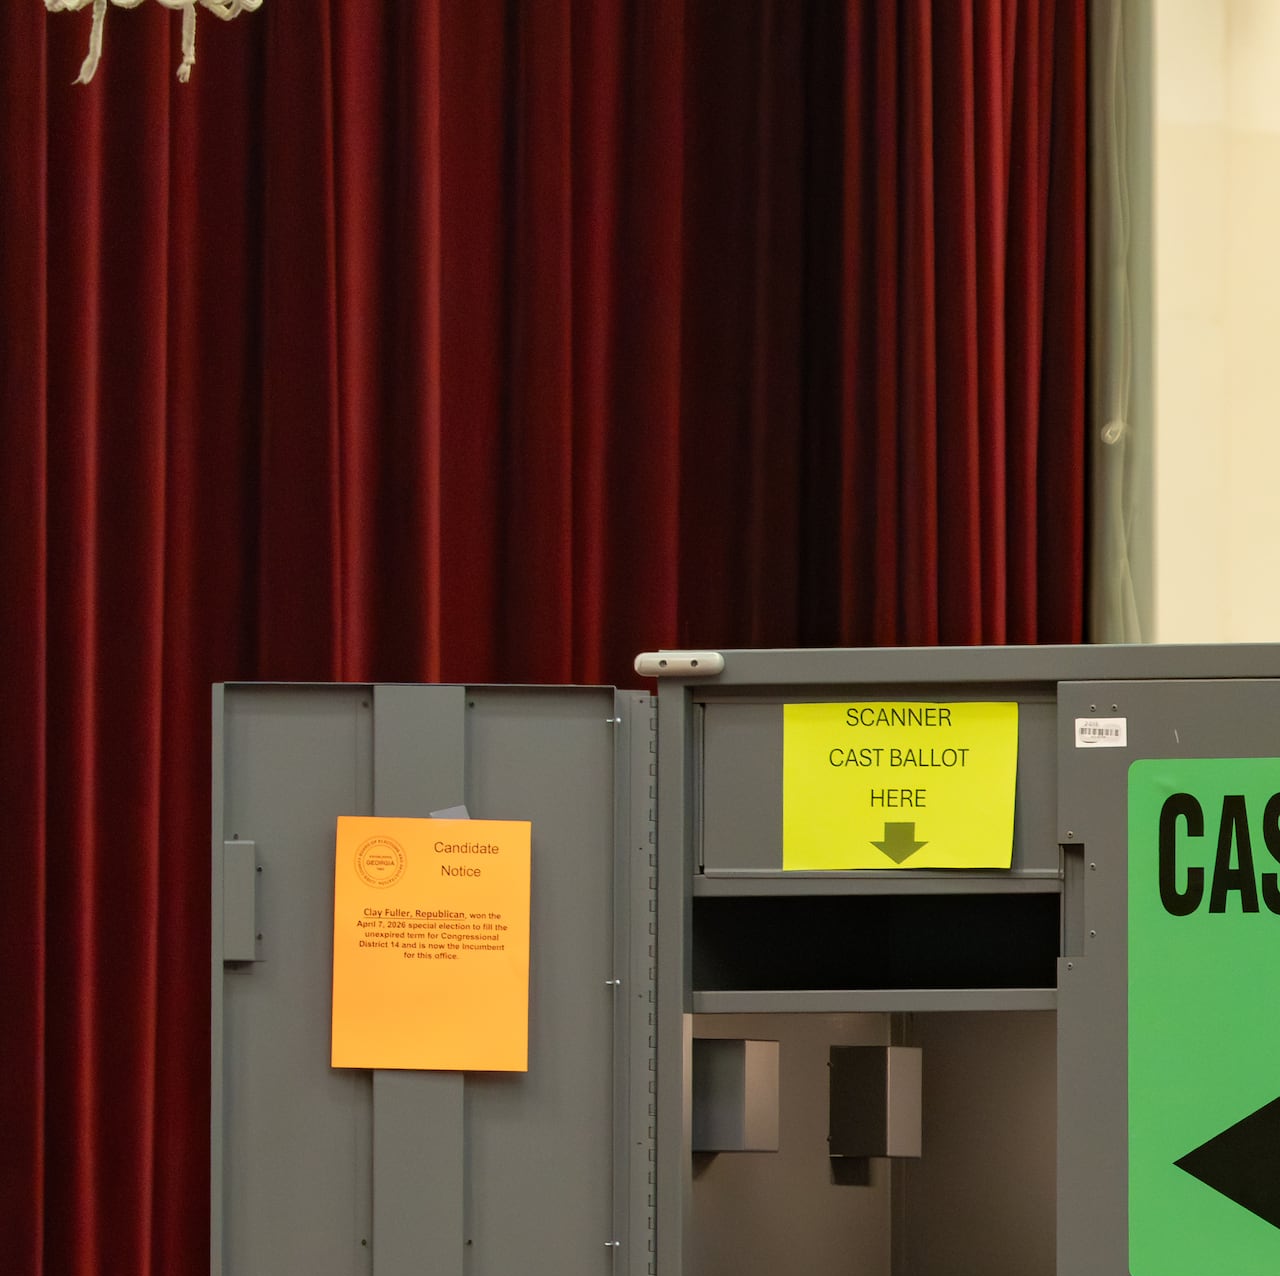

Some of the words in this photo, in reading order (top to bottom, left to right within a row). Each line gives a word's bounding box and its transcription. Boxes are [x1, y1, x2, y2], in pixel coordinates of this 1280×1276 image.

[846, 708, 952, 727] SCANNER
[829, 748, 883, 767] CAST
[890, 748, 969, 767] BALLOT
[871, 789, 926, 807] HERE
[434, 841, 499, 854] Candidate
[441, 865, 481, 878] Notice
[363, 908, 383, 918] Clay
[357, 920, 376, 928] April
[387, 921, 406, 929] 2026
[408, 922, 437, 930] special
[438, 922, 470, 930] election
[403, 951, 415, 959] for
